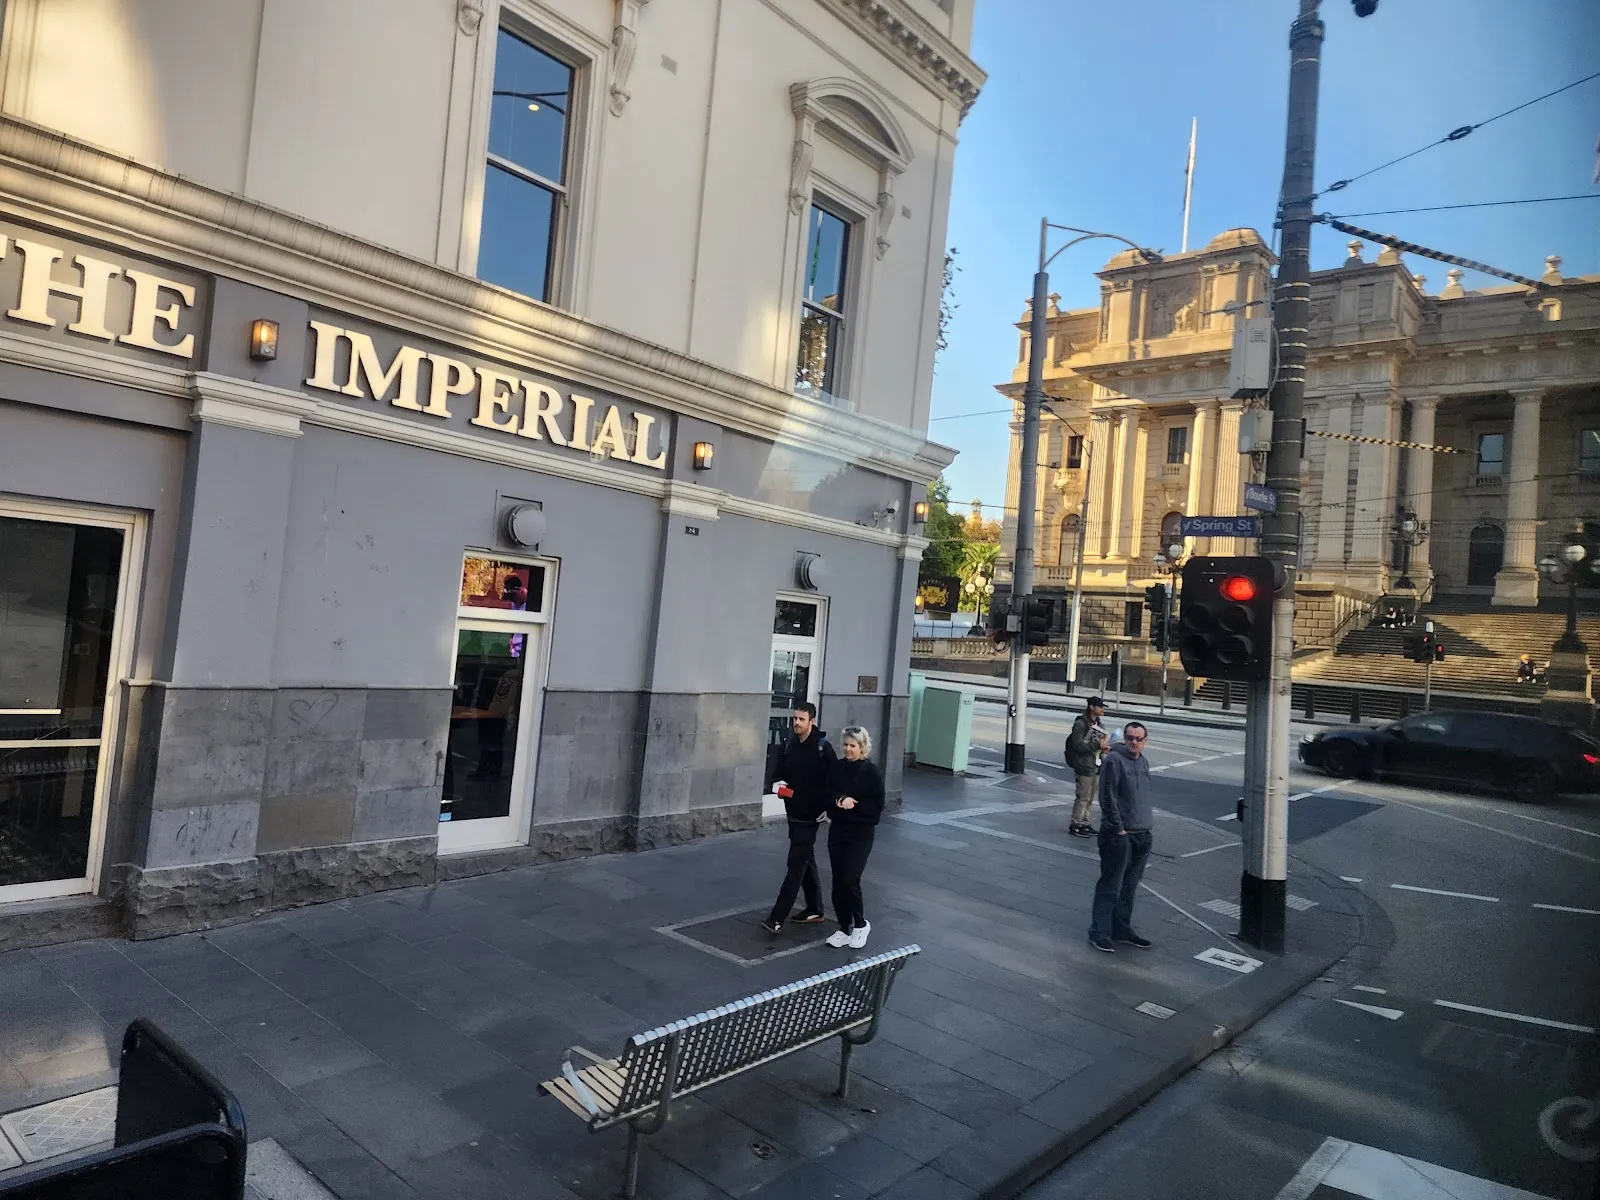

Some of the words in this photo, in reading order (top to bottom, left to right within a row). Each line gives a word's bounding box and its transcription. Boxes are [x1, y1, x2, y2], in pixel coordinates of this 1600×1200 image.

[0, 233, 196, 359] HE
[305, 319, 667, 471] IMPERIAL
[1249, 487, 1268, 503] Bourke
[1268, 493, 1276, 505] St
[1193, 519, 1233, 533] Spring
[1237, 519, 1252, 531] St
